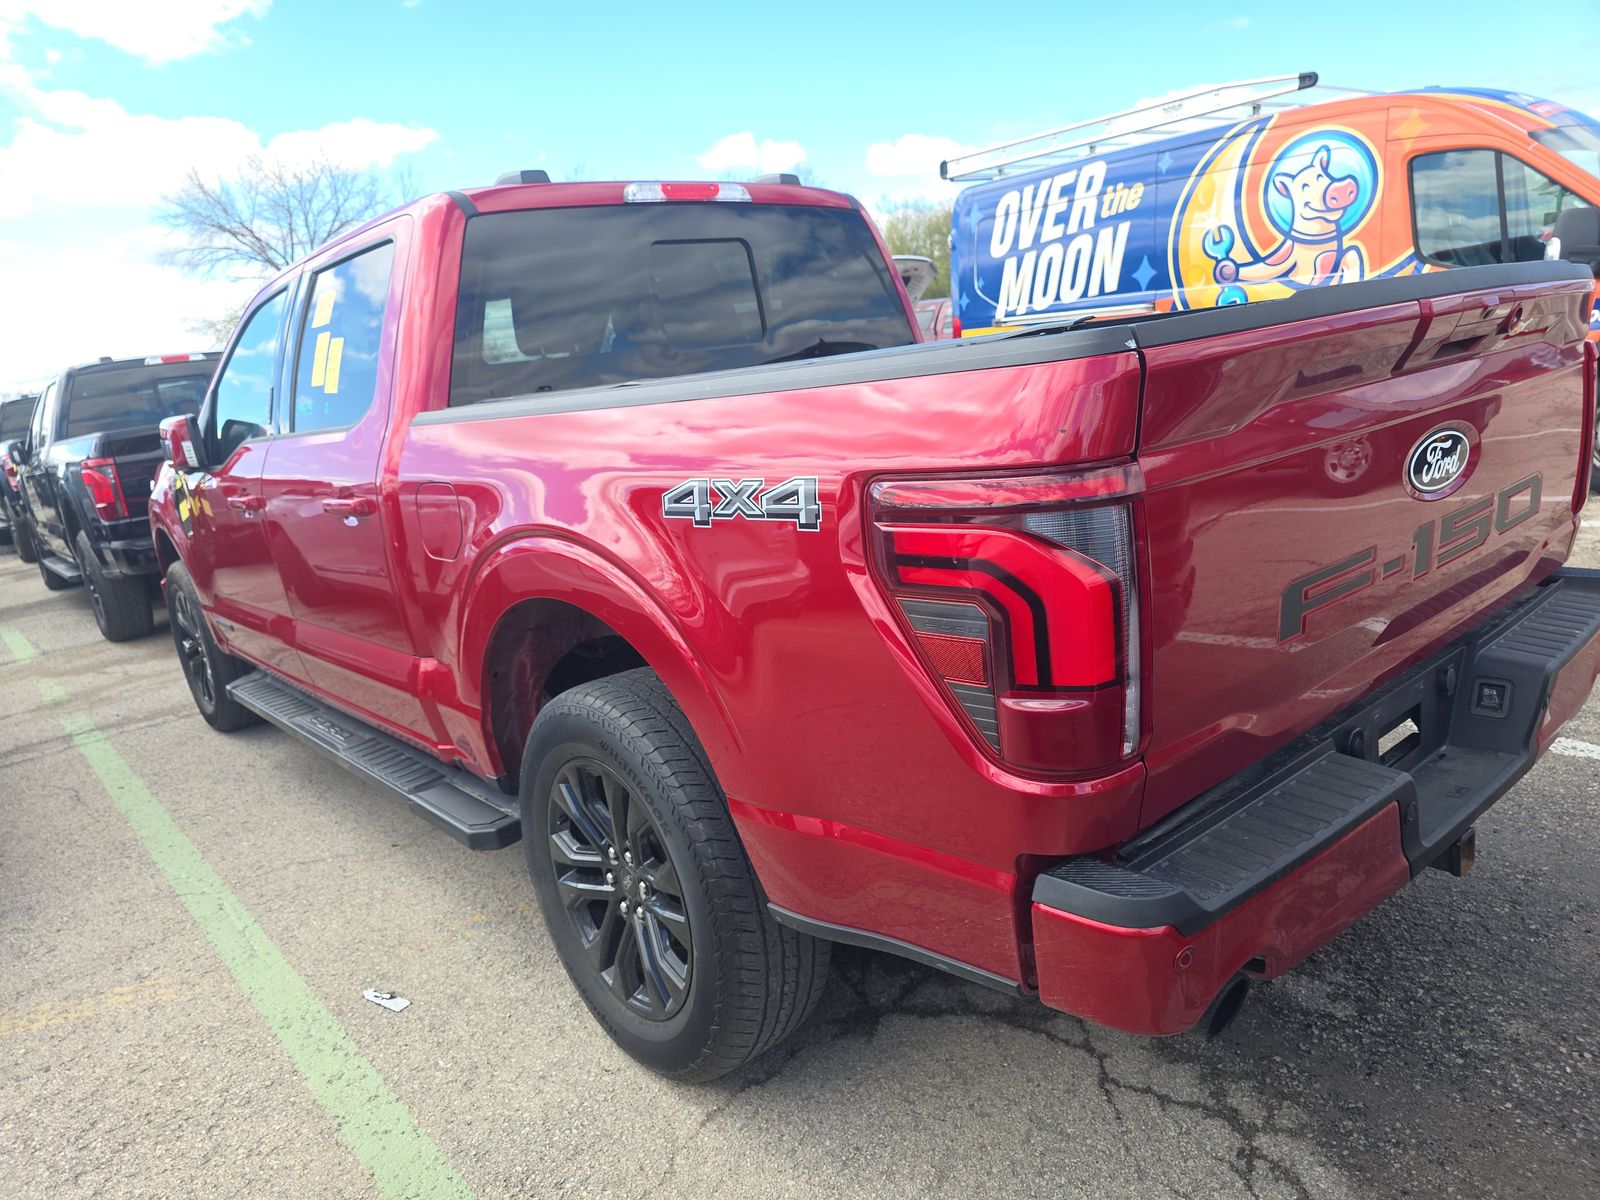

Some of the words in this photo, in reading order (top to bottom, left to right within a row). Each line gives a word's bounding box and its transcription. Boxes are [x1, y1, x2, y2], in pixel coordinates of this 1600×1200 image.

[990, 160, 1108, 259] OVER
[1101, 182, 1145, 219] the
[995, 220, 1131, 320] MOON
[1422, 439, 1462, 484] Ford
[1278, 471, 1543, 647] F-150
